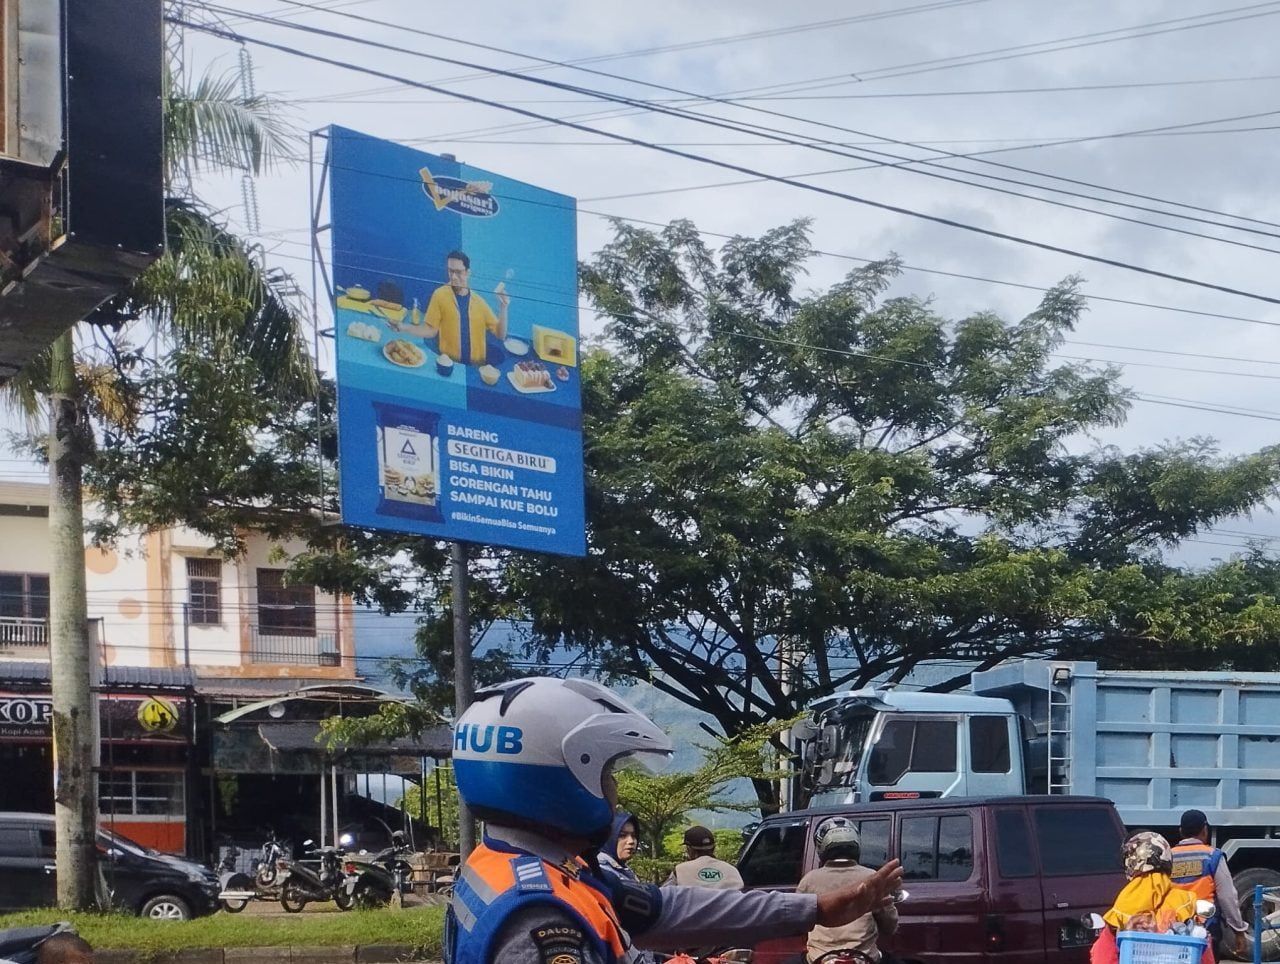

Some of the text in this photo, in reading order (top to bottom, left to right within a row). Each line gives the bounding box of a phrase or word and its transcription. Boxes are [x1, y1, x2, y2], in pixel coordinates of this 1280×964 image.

[447, 424, 498, 443] BARENG
[454, 442, 547, 469] SEGITIGA BIRU
[449, 459, 514, 480] BISA BIKIN
[449, 475, 552, 502] GORENGAN TAHU
[450, 491, 558, 517] SAMPAI KUE BOLU
